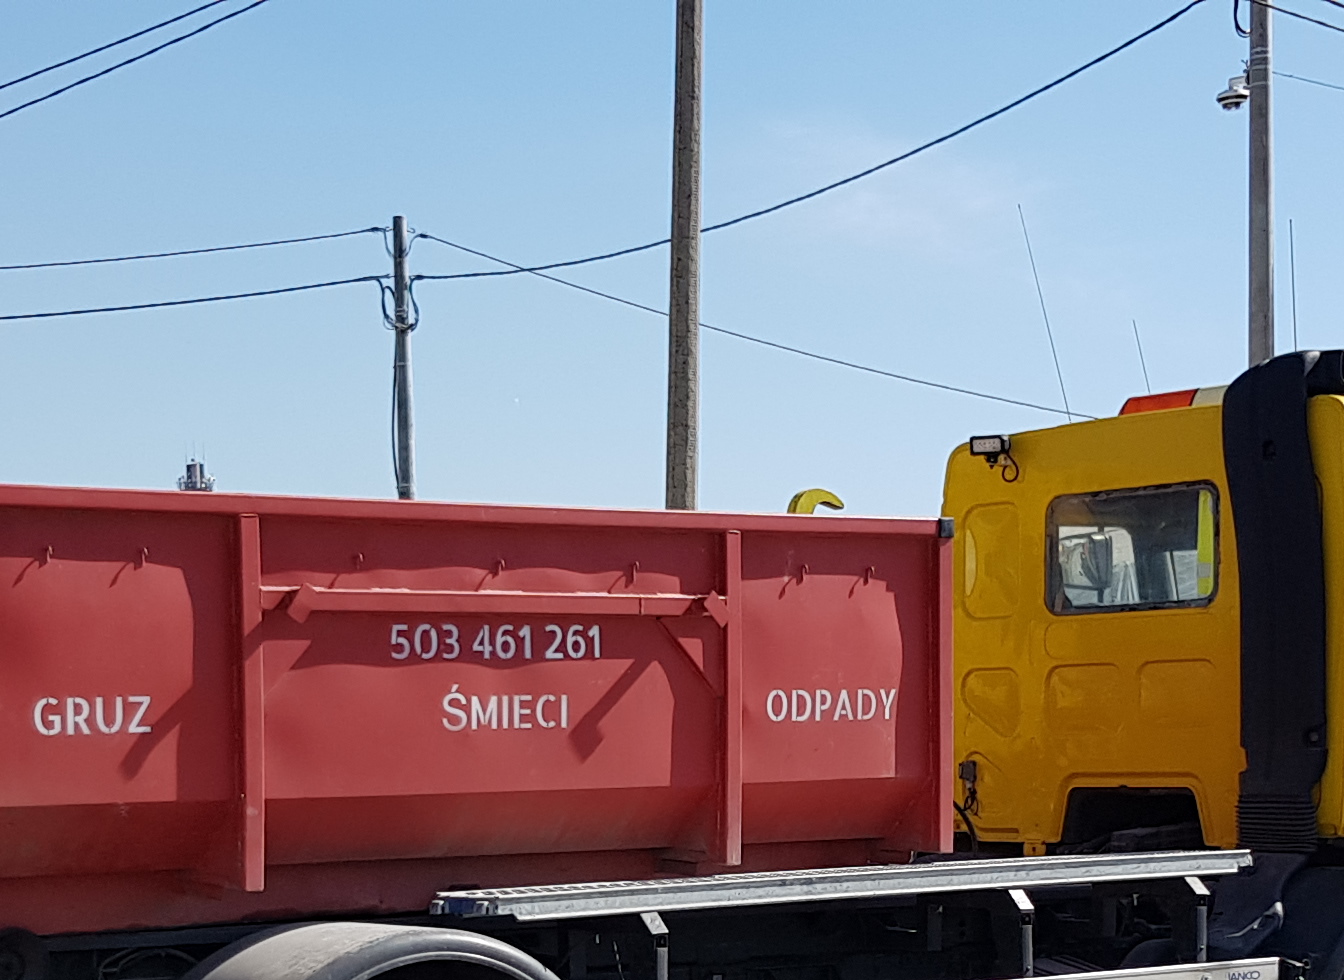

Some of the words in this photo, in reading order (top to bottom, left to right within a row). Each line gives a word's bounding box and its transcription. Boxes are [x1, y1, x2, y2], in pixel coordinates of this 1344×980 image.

[390, 623, 460, 660] 503
[472, 624, 533, 660] 461
[544, 624, 602, 659] 261
[33, 695, 152, 736] GRUZ
[442, 684, 569, 732] ŚMIECI
[766, 688, 896, 723] ODPADY
